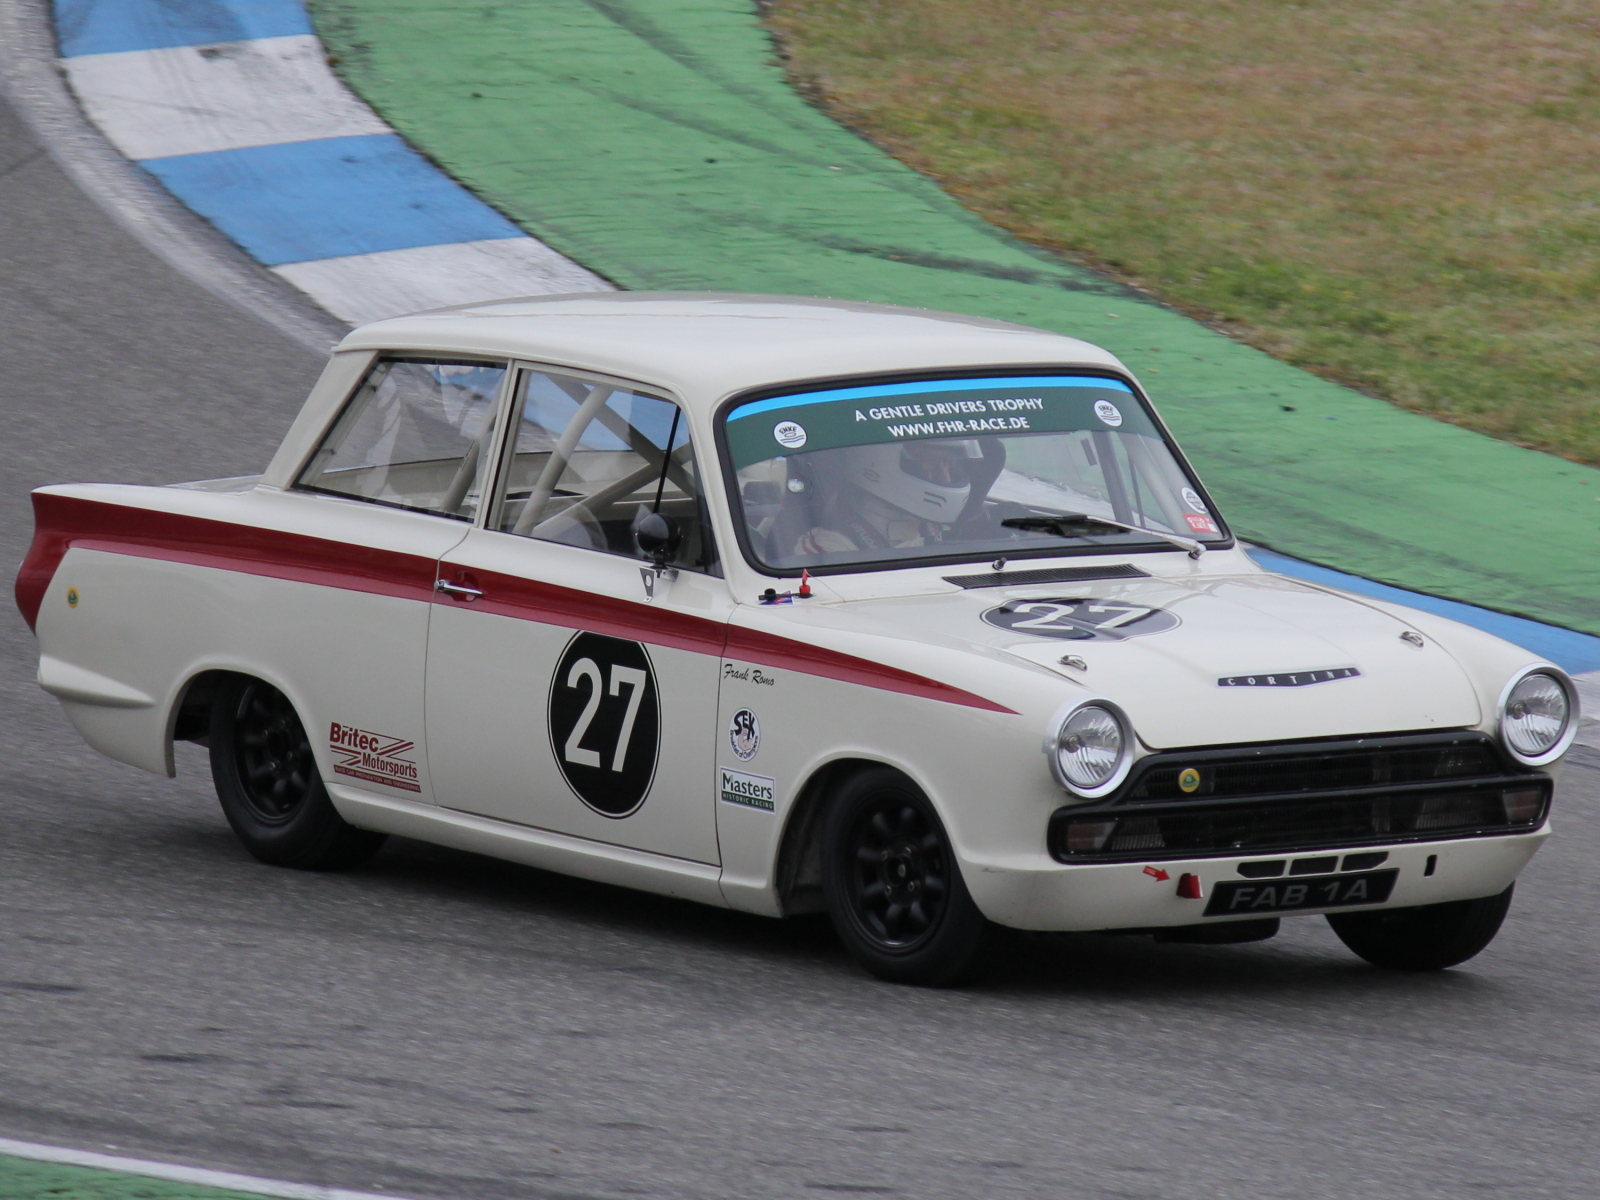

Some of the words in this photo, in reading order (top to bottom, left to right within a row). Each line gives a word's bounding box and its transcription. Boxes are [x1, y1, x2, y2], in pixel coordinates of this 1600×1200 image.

[855, 409, 867, 422] A
[869, 404, 924, 420] GENTLE
[926, 400, 986, 416] DRIVERS
[987, 398, 1044, 412] TROPHY
[887, 416, 1030, 438] WWW.FHR-RACE.DE
[1011, 602, 1151, 631] 27
[723, 663, 750, 681] Frank
[751, 669, 775, 687] Romo
[1227, 669, 1352, 686] CORTINA
[564, 657, 647, 773] 27
[733, 709, 755, 742] SEX
[329, 721, 379, 753] Britec
[362, 751, 418, 779] Motorsports
[722, 771, 773, 800] Masters
[722, 792, 749, 804] HISTORIC
[751, 799, 773, 809] RACING
[1229, 884, 1309, 910] FAB
[1320, 878, 1369, 902] 1A
